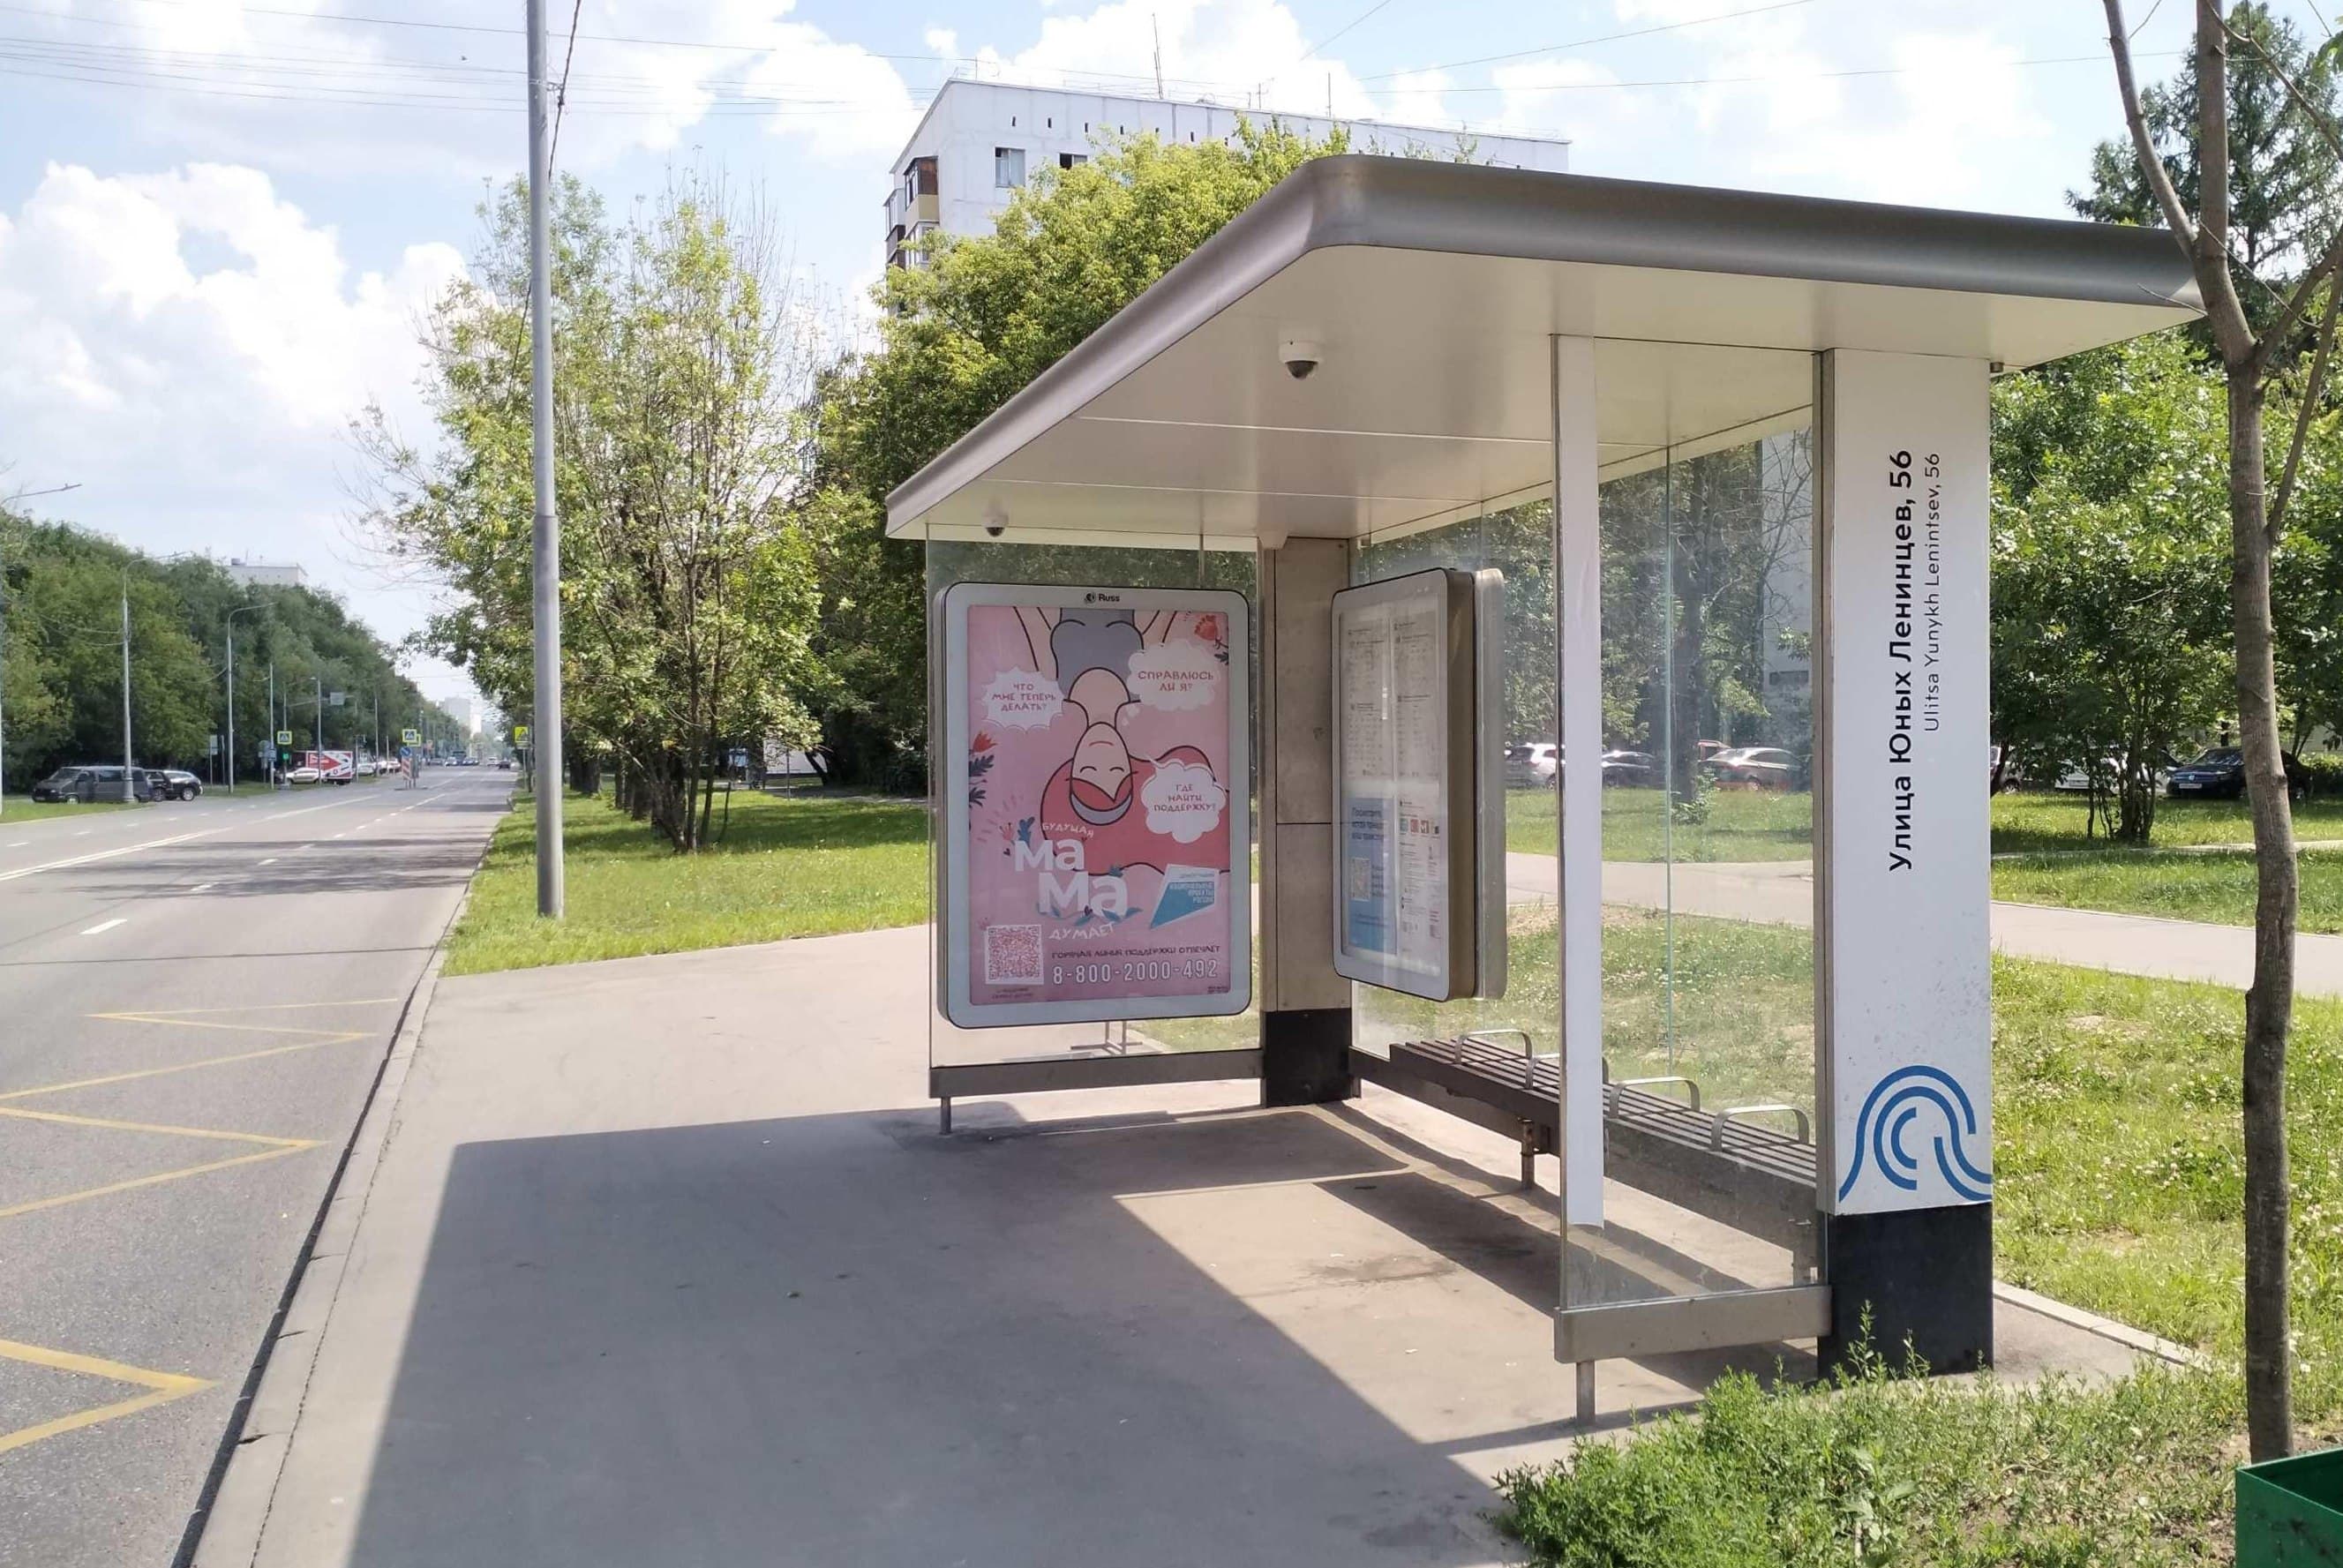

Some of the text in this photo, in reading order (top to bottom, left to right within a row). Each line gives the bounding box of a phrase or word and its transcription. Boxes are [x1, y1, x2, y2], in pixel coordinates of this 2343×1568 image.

[1923, 453, 1942, 731] Ulitsa Yunykh Lenintsev, 56
[1098, 593, 1121, 602] Russ
[1889, 450, 1916, 872] Улица Юных Ленинцев, 56
[1138, 671, 1214, 681] СПРАВЛЮСЬ
[1013, 683, 1035, 692] ЧТО
[1159, 682, 1194, 692] ЛИ Я?
[991, 693, 1057, 701] МНЕ ТЕПЕРЬ
[1000, 702, 1048, 712] ДЕЛАТЬ?
[1175, 784, 1194, 792] ГДЕ
[1153, 803, 1216, 813] ПОДДЕРЖКУ?
[1048, 922, 1115, 941] ДУМАЕТ
[1053, 959, 1218, 986] 8-800-2000-492
